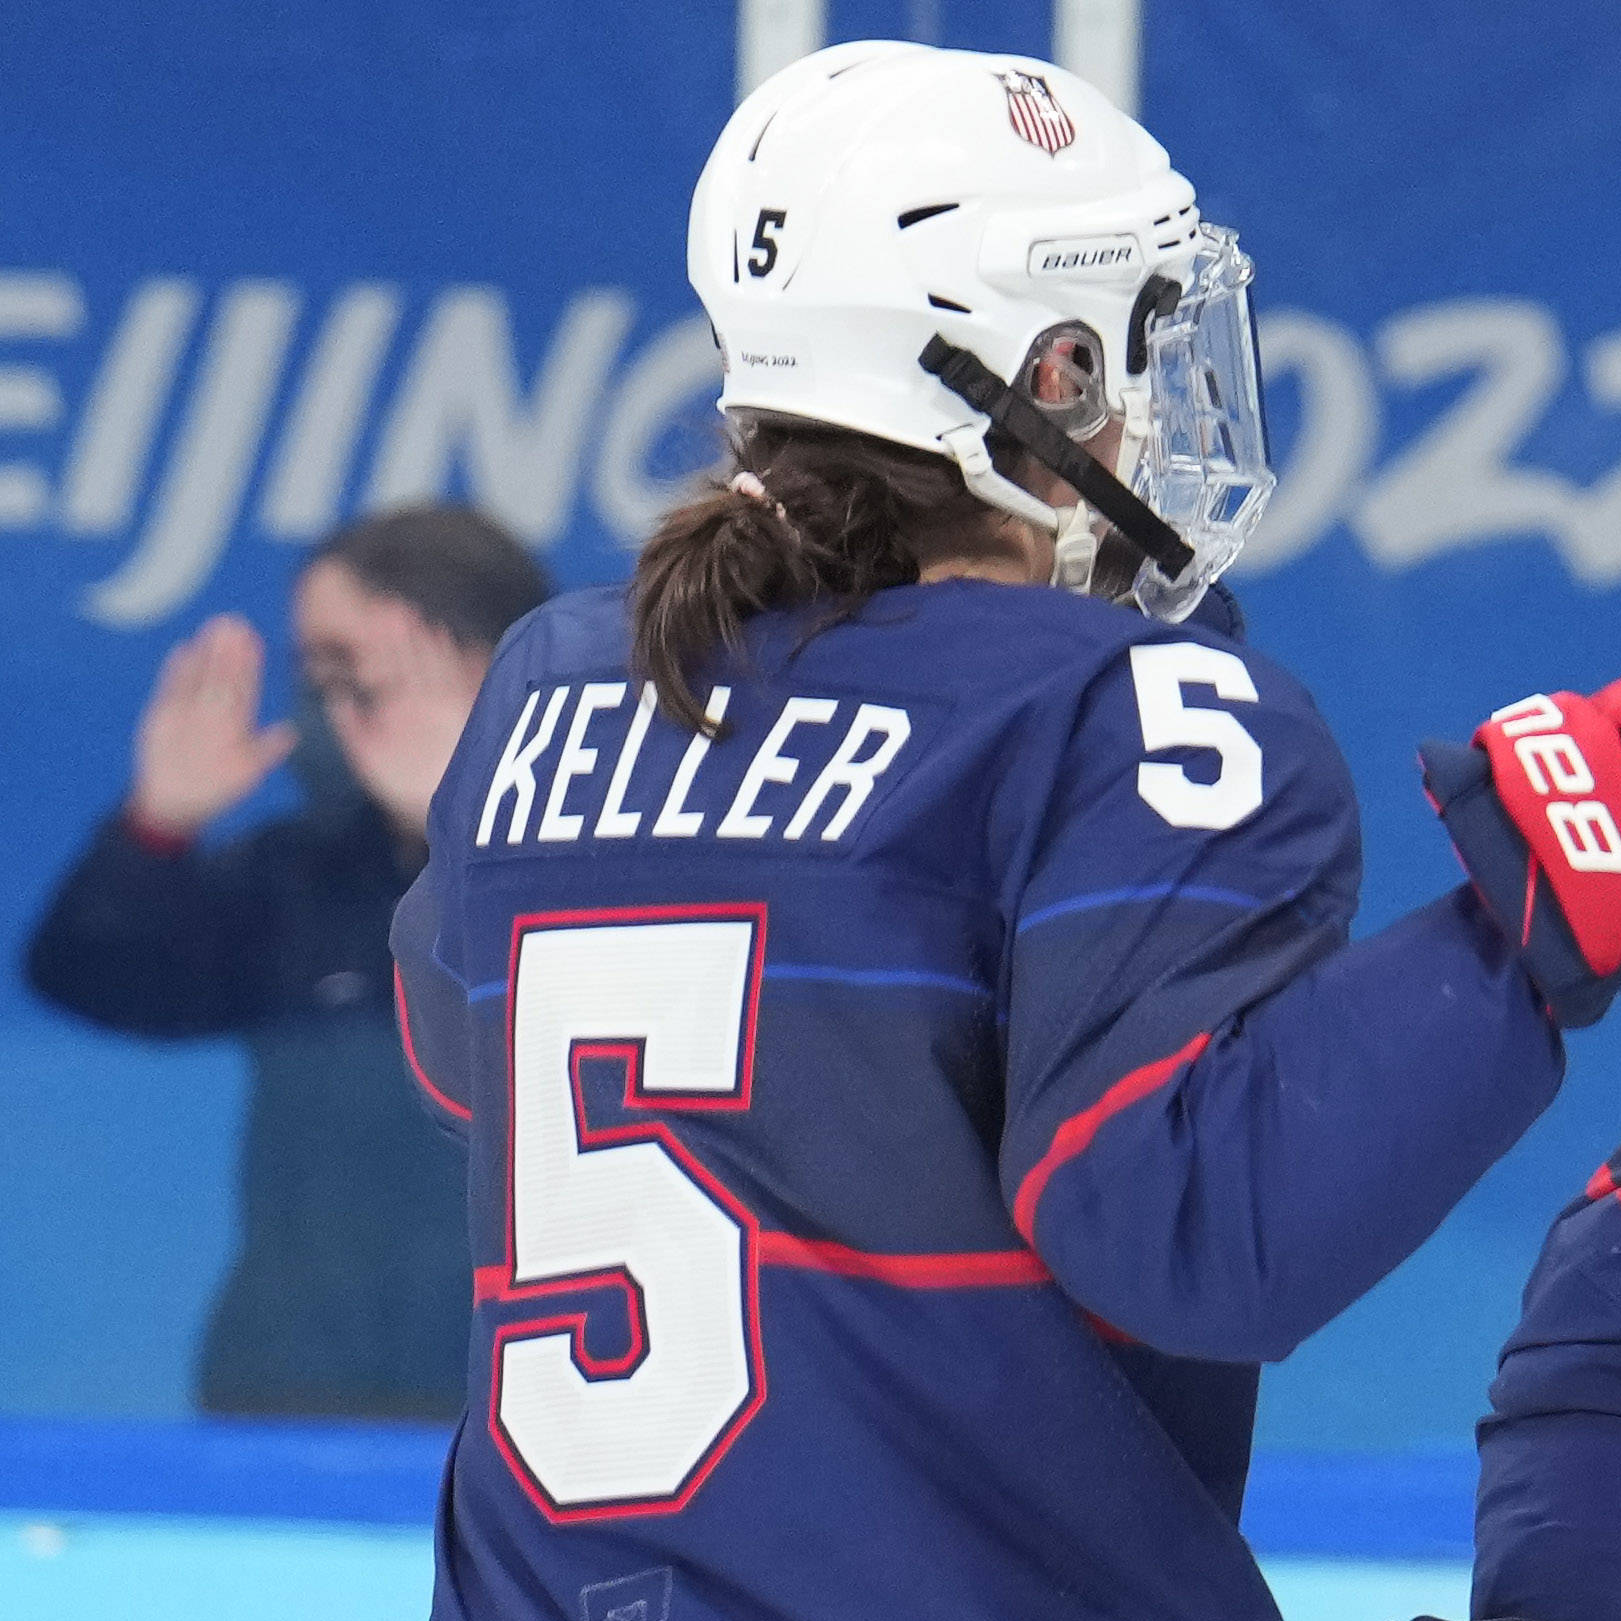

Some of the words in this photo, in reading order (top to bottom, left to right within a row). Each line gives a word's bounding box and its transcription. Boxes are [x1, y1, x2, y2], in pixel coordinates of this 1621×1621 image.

[748, 208, 787, 279] 5
[476, 679, 912, 848] KELLER
[1129, 641, 1263, 831] 5
[489, 902, 768, 1524] 5
